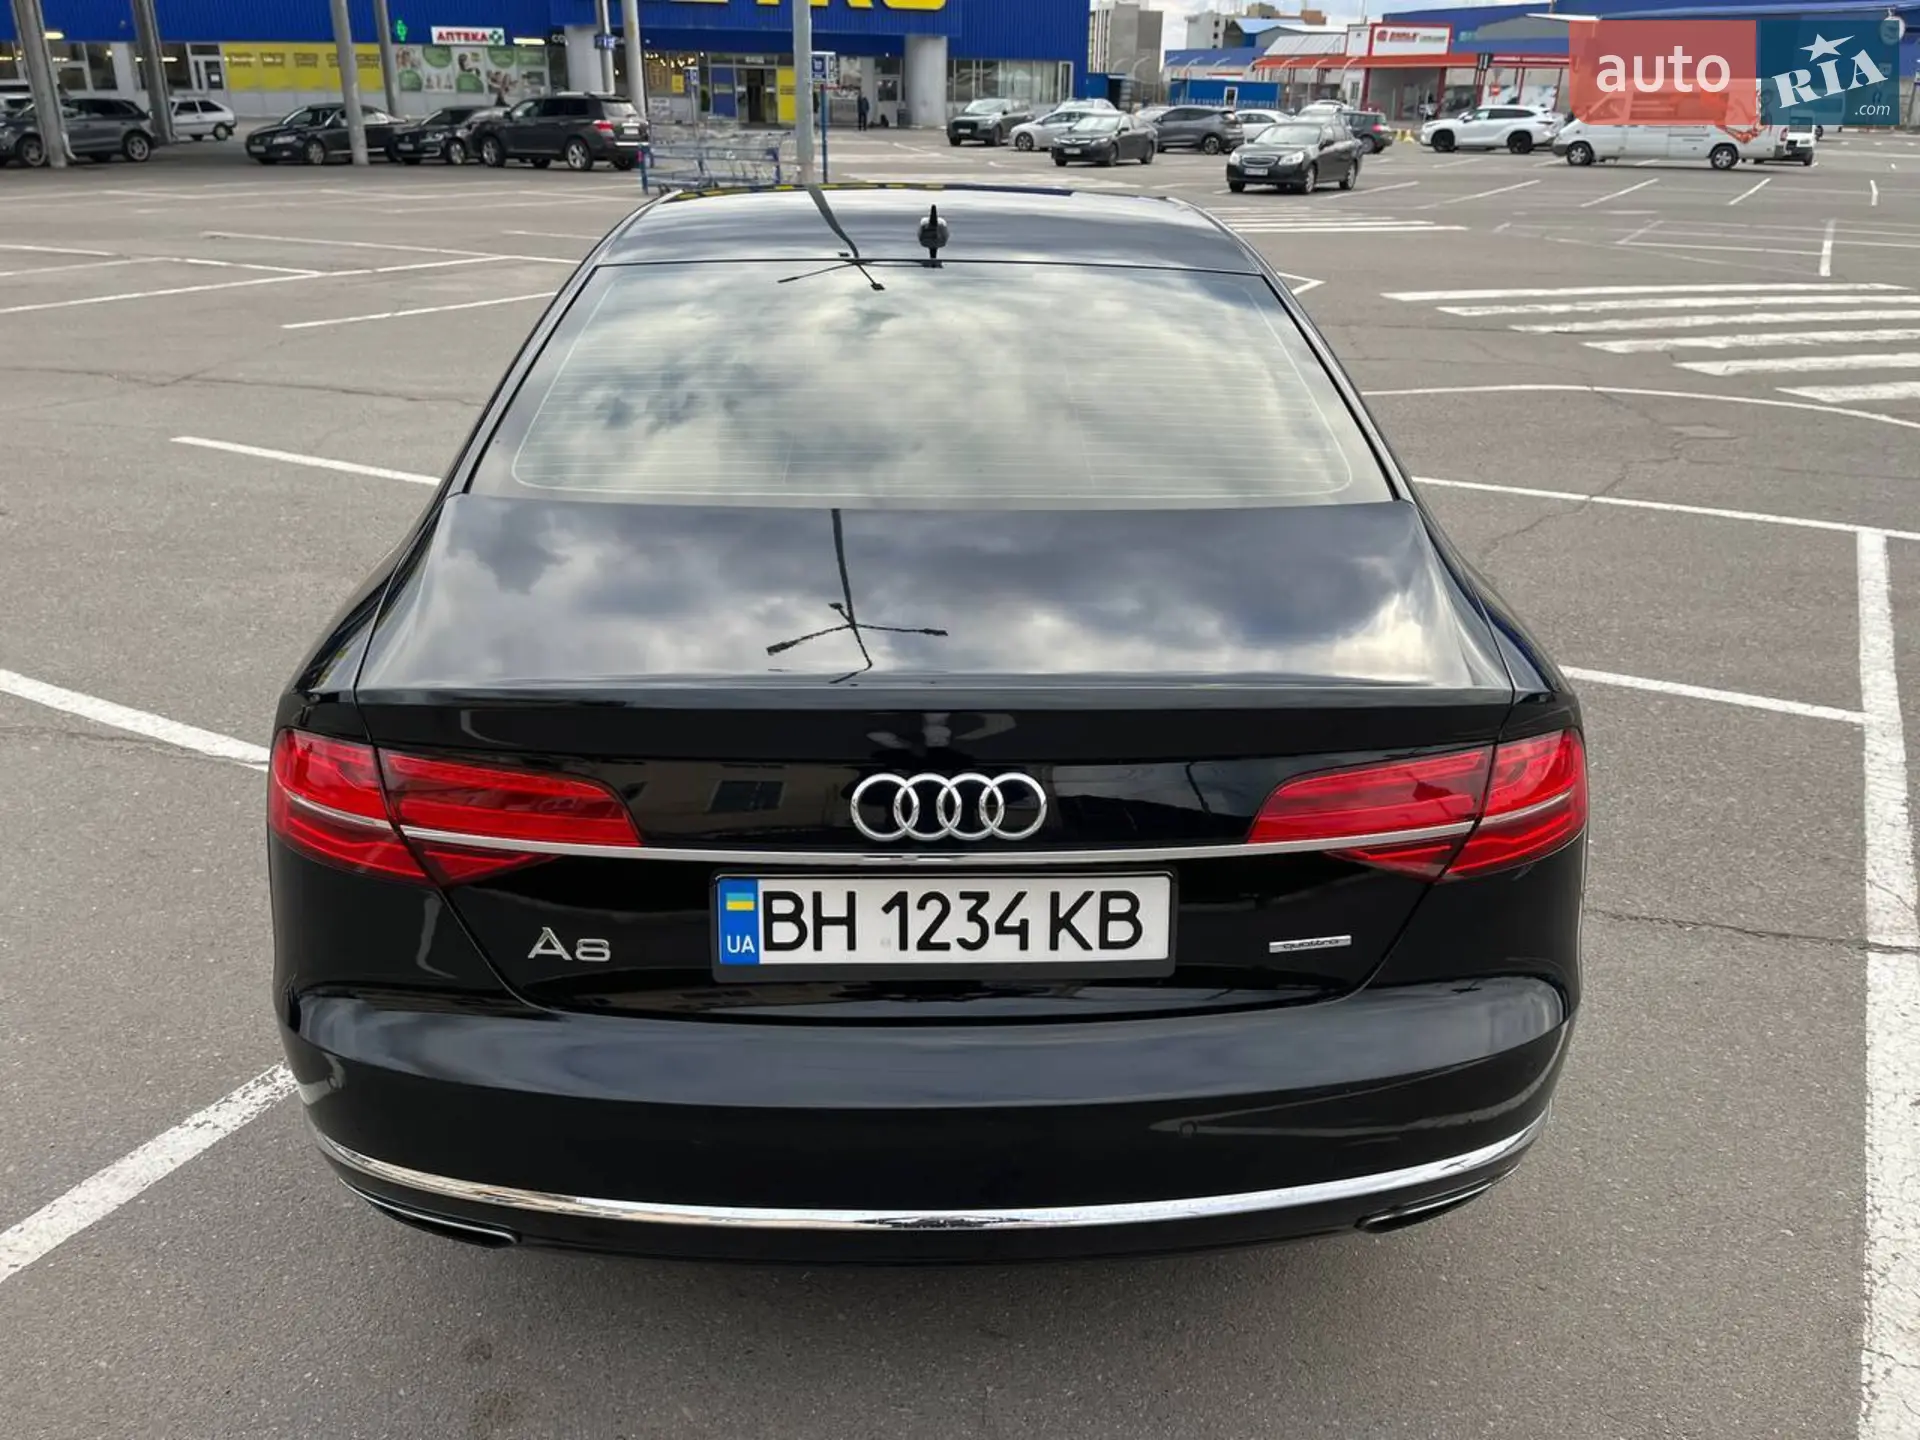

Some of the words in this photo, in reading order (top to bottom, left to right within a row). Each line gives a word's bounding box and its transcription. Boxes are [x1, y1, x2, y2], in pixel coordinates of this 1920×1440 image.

[437, 31, 489, 42] АПТЕКА
[763, 890, 857, 951] BH
[881, 890, 1030, 951] 1234
[1049, 890, 1144, 951] KB
[527, 926, 611, 962] A8
[726, 935, 755, 954] UA
